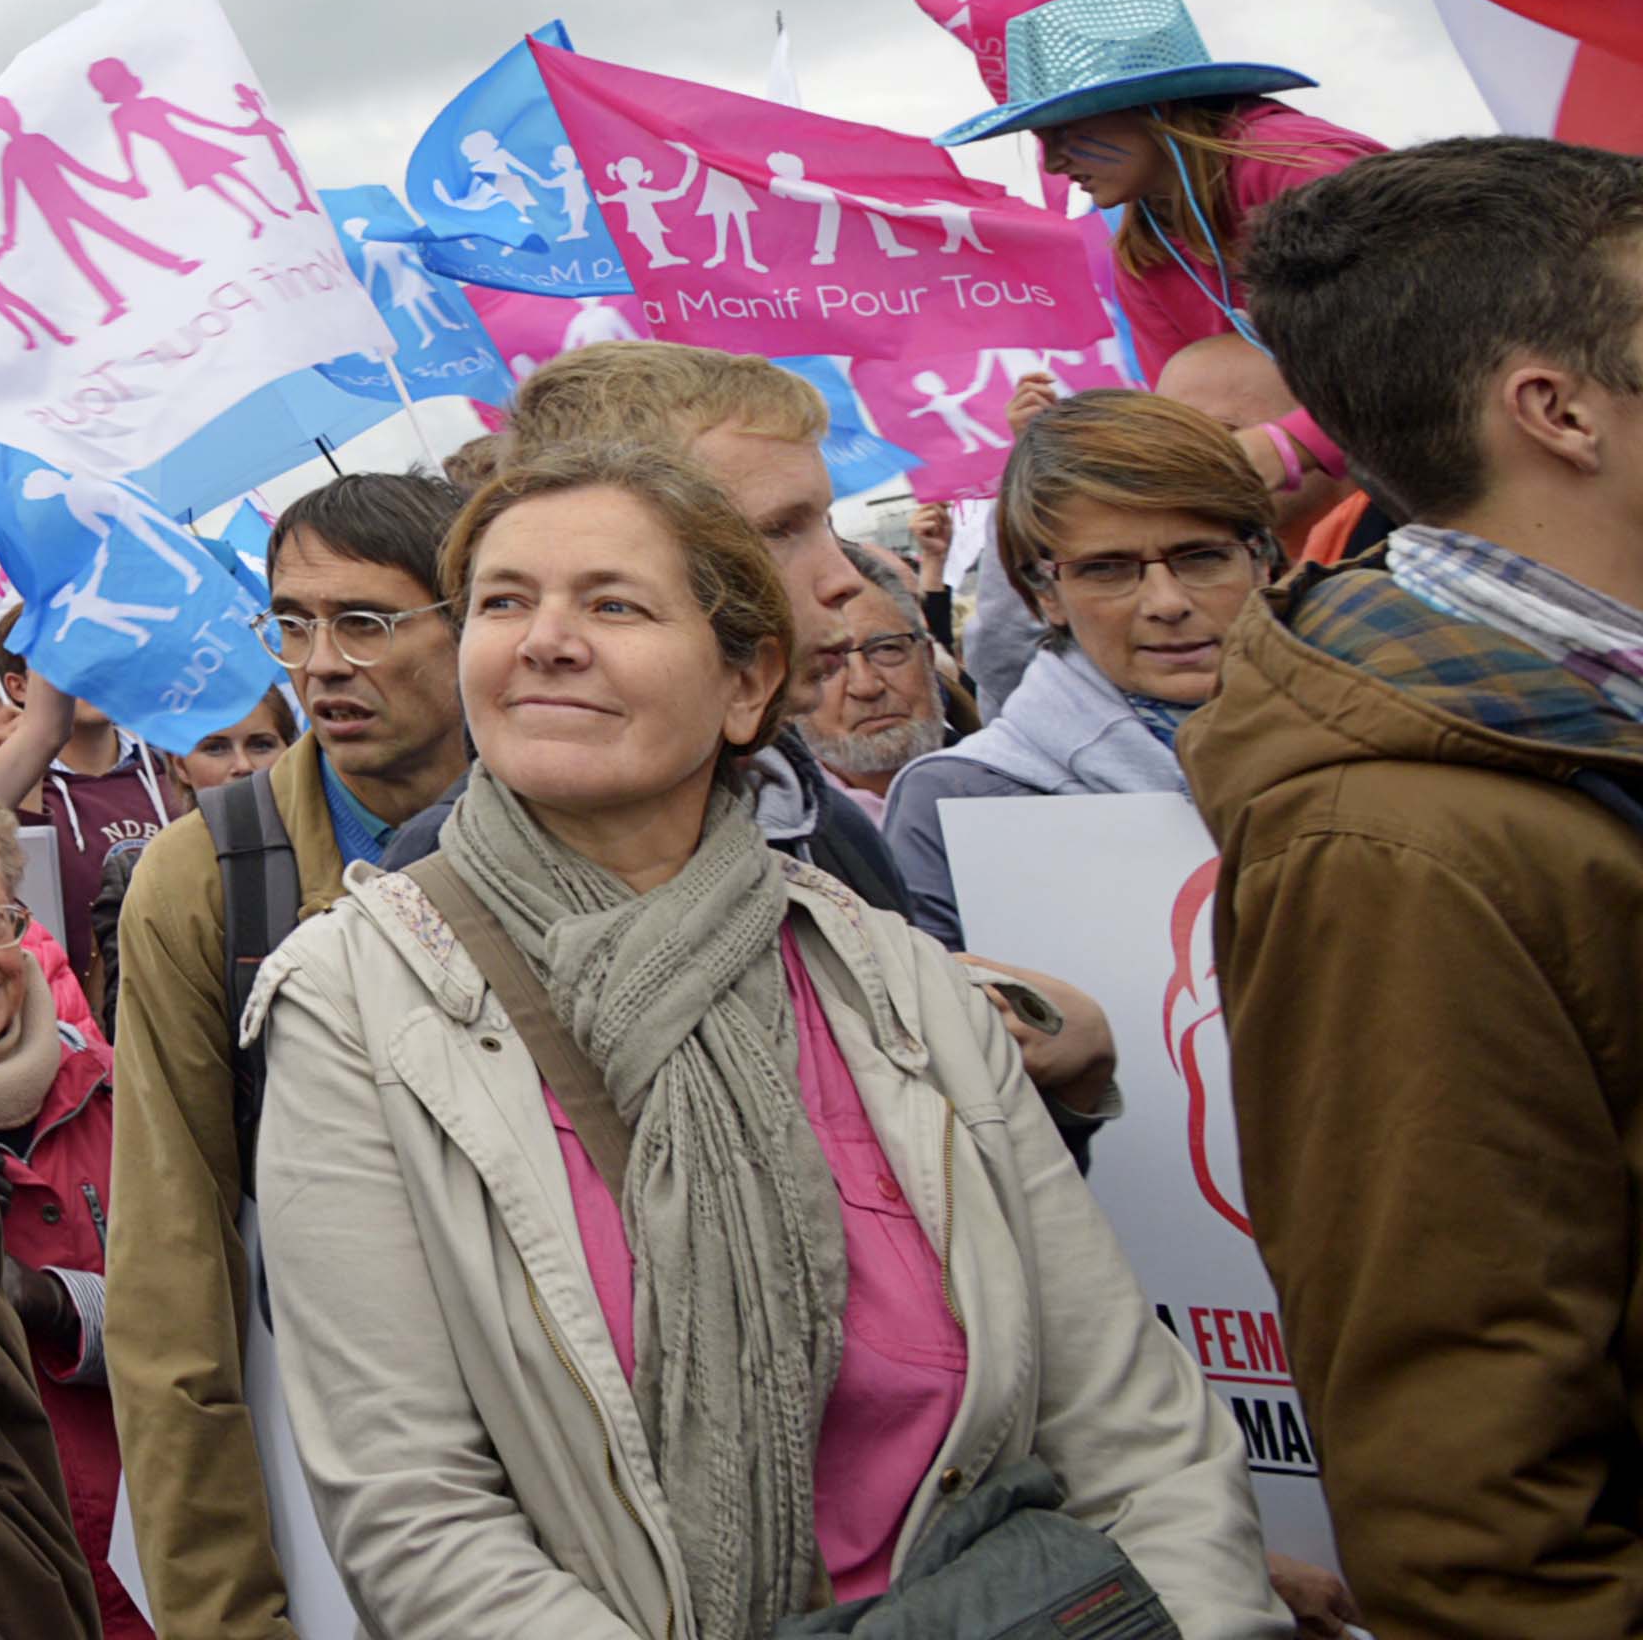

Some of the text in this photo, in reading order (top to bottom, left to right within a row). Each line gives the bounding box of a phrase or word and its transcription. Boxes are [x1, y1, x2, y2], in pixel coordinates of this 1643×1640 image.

[974, 36, 1006, 102] ous
[643, 273, 1056, 324] a Manif Pour Tous
[1188, 1306, 1290, 1373] FEM
[1231, 1396, 1319, 1464] MA
